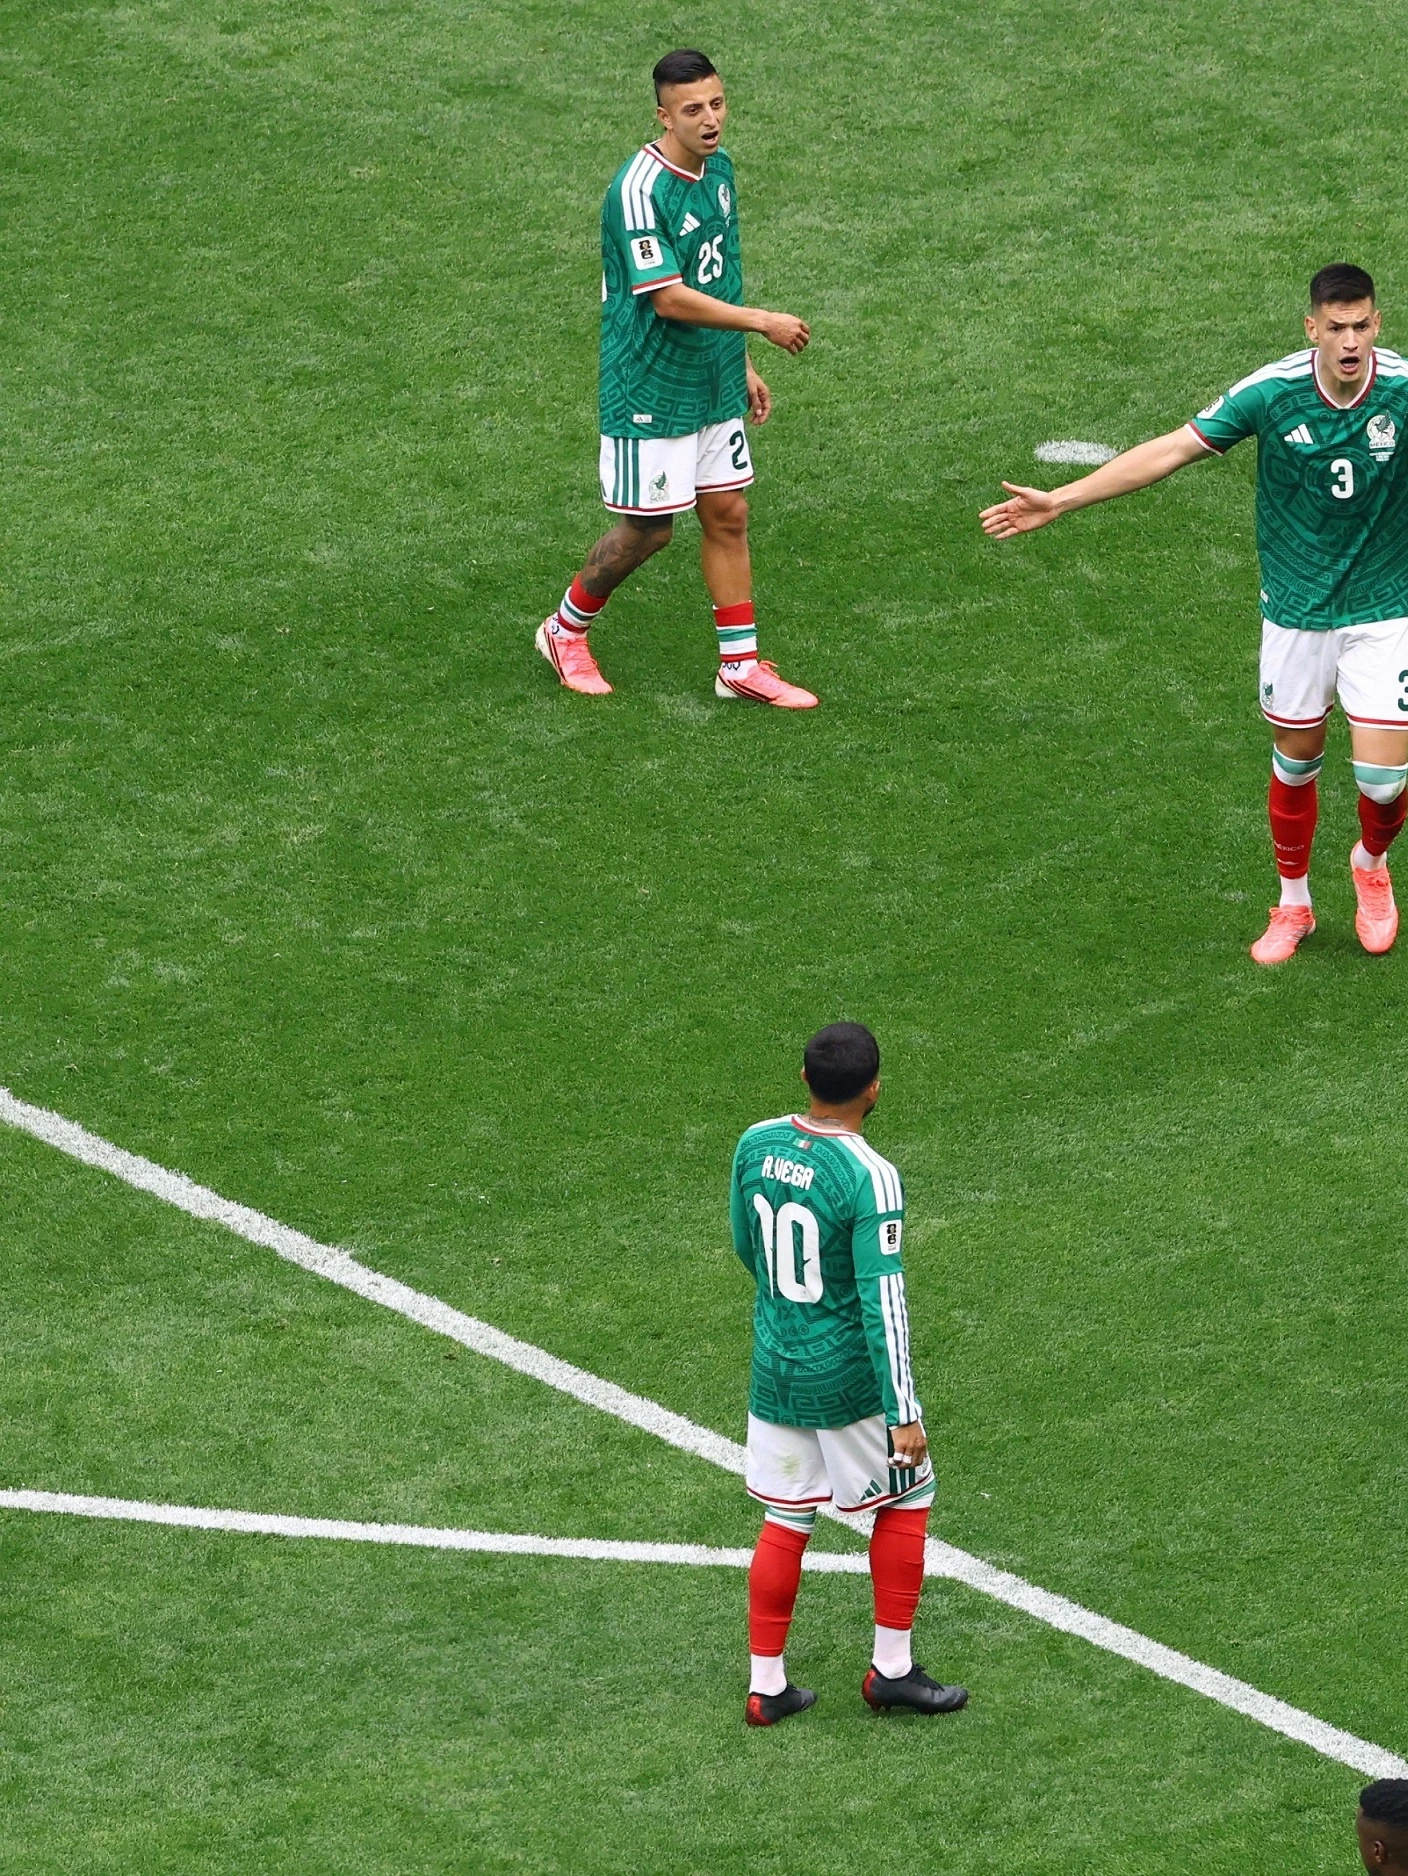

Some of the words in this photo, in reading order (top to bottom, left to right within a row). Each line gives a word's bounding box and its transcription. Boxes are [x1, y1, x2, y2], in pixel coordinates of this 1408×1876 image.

[697, 234, 723, 284] 25
[729, 430, 748, 470] 2
[1330, 458, 1354, 499] 3
[761, 1155, 815, 1191] A.VEGA
[753, 1192, 824, 1304] 10
